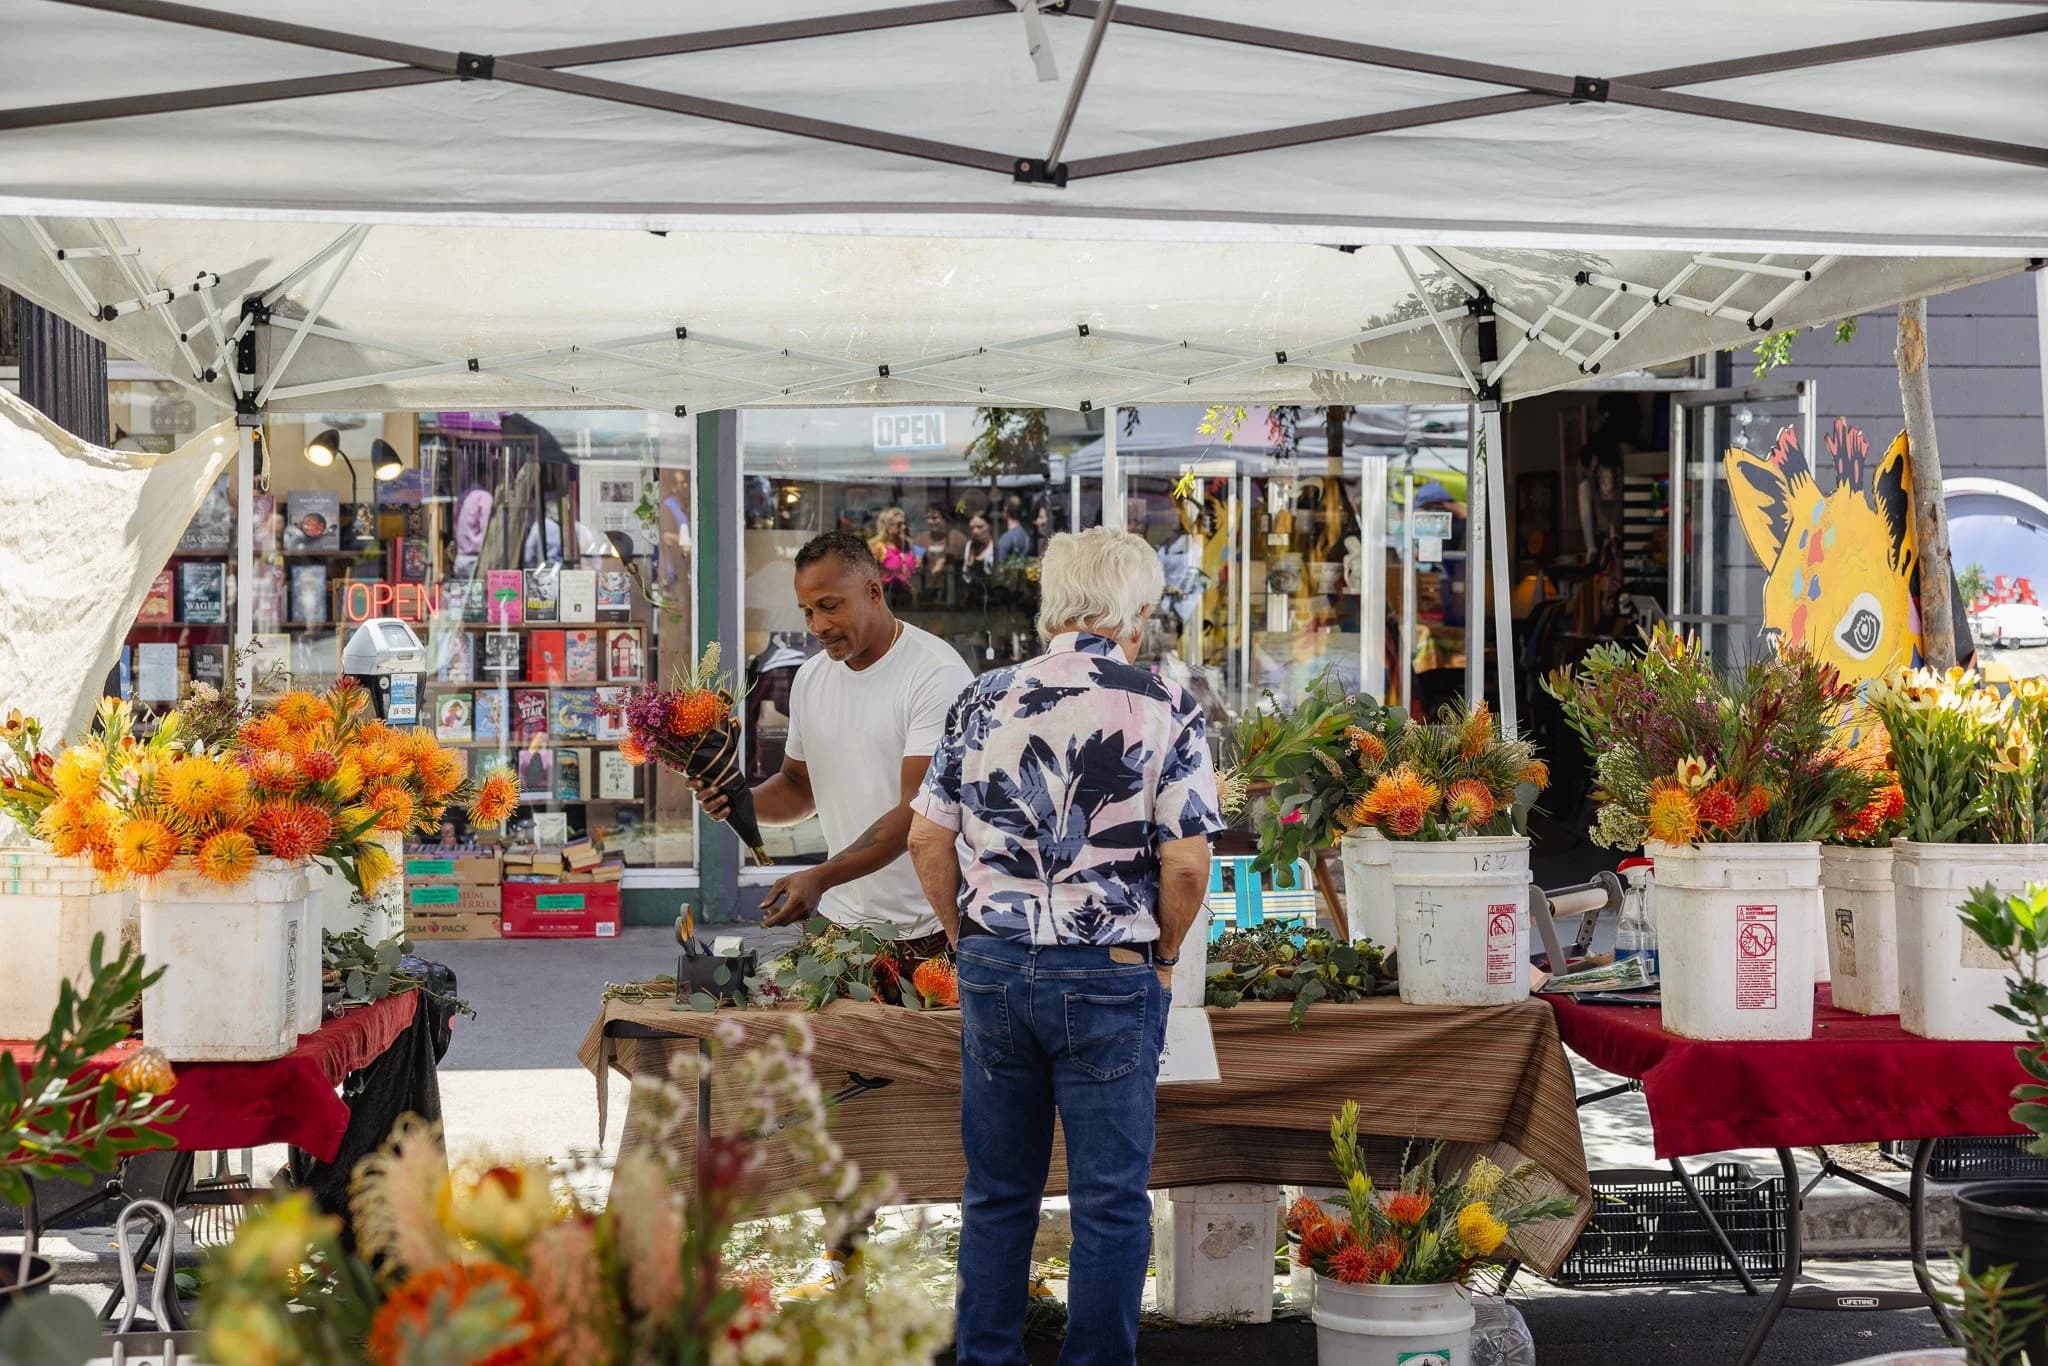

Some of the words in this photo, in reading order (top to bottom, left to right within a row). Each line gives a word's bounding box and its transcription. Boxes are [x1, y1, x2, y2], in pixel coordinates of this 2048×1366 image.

[878, 415, 942, 446] OPEN
[185, 601, 221, 610] WAGER
[347, 583, 439, 621] OPEN
[521, 706, 543, 719] STAIR
[441, 925, 468, 933] PACK
